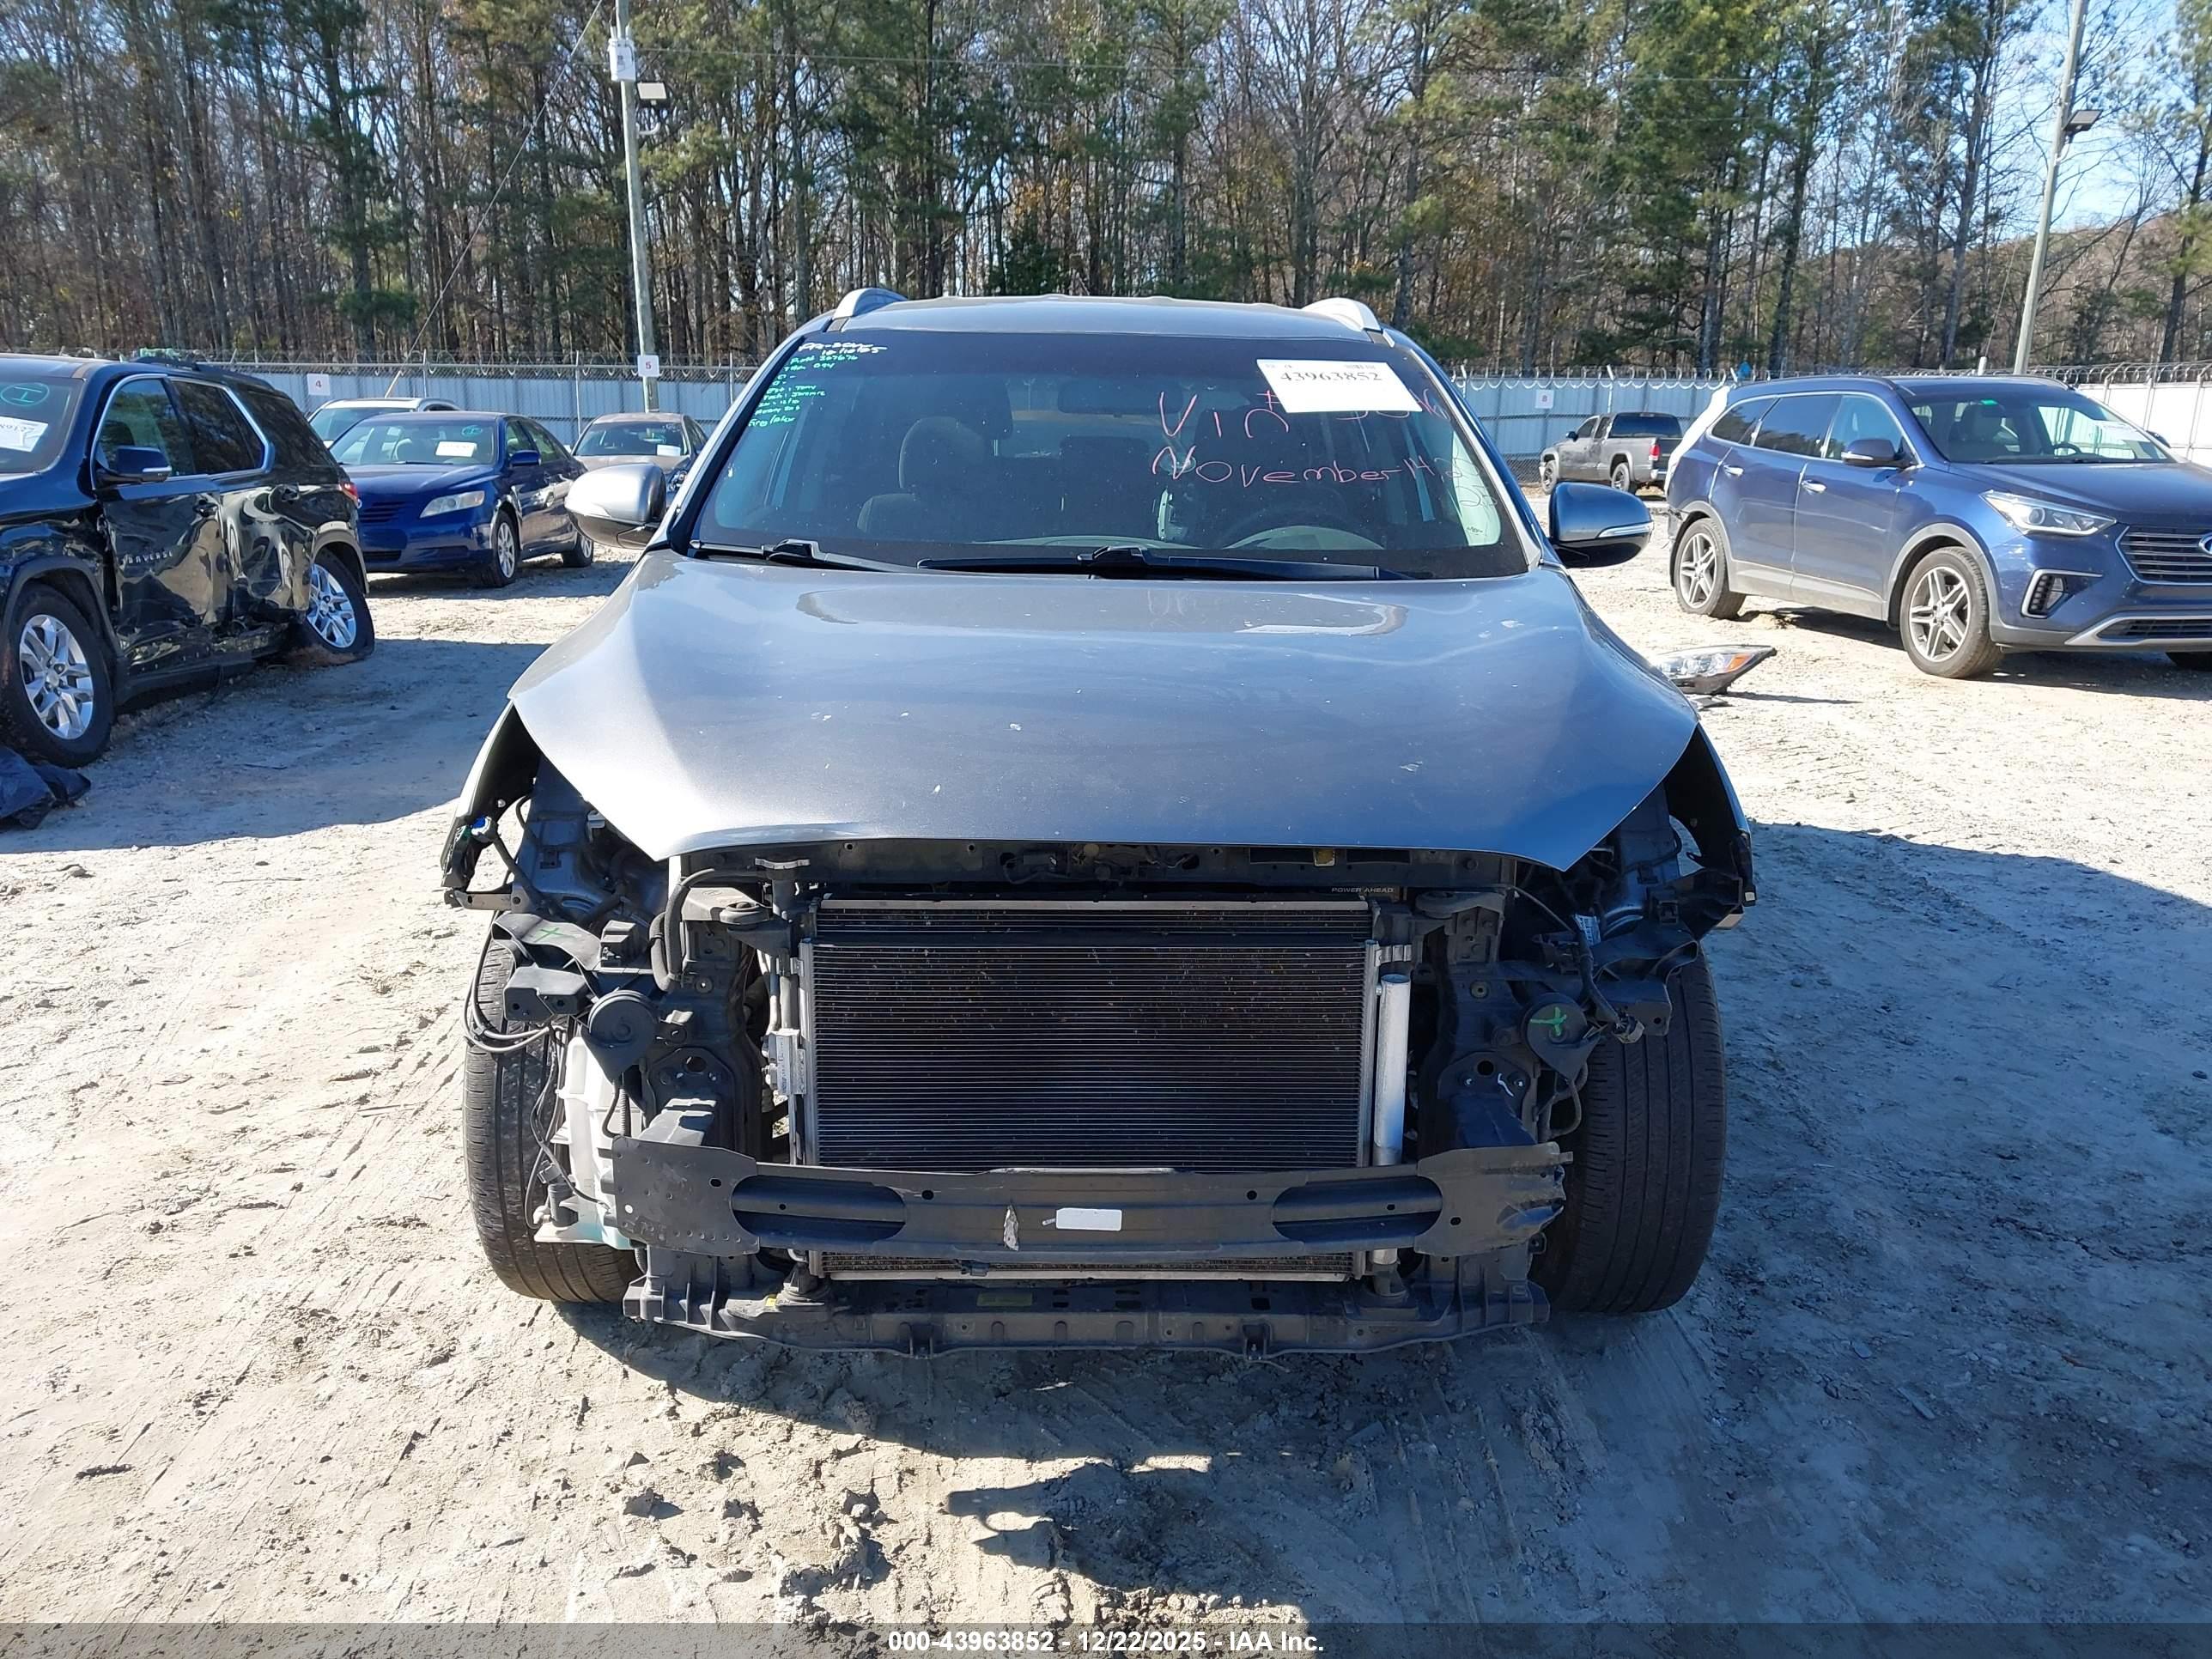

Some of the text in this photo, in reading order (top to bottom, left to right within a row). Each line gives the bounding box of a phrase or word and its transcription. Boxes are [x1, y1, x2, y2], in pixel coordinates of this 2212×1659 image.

[646, 361, 652, 369] 5
[1279, 371, 1383, 381] 43963852
[316, 380, 322, 388] 4
